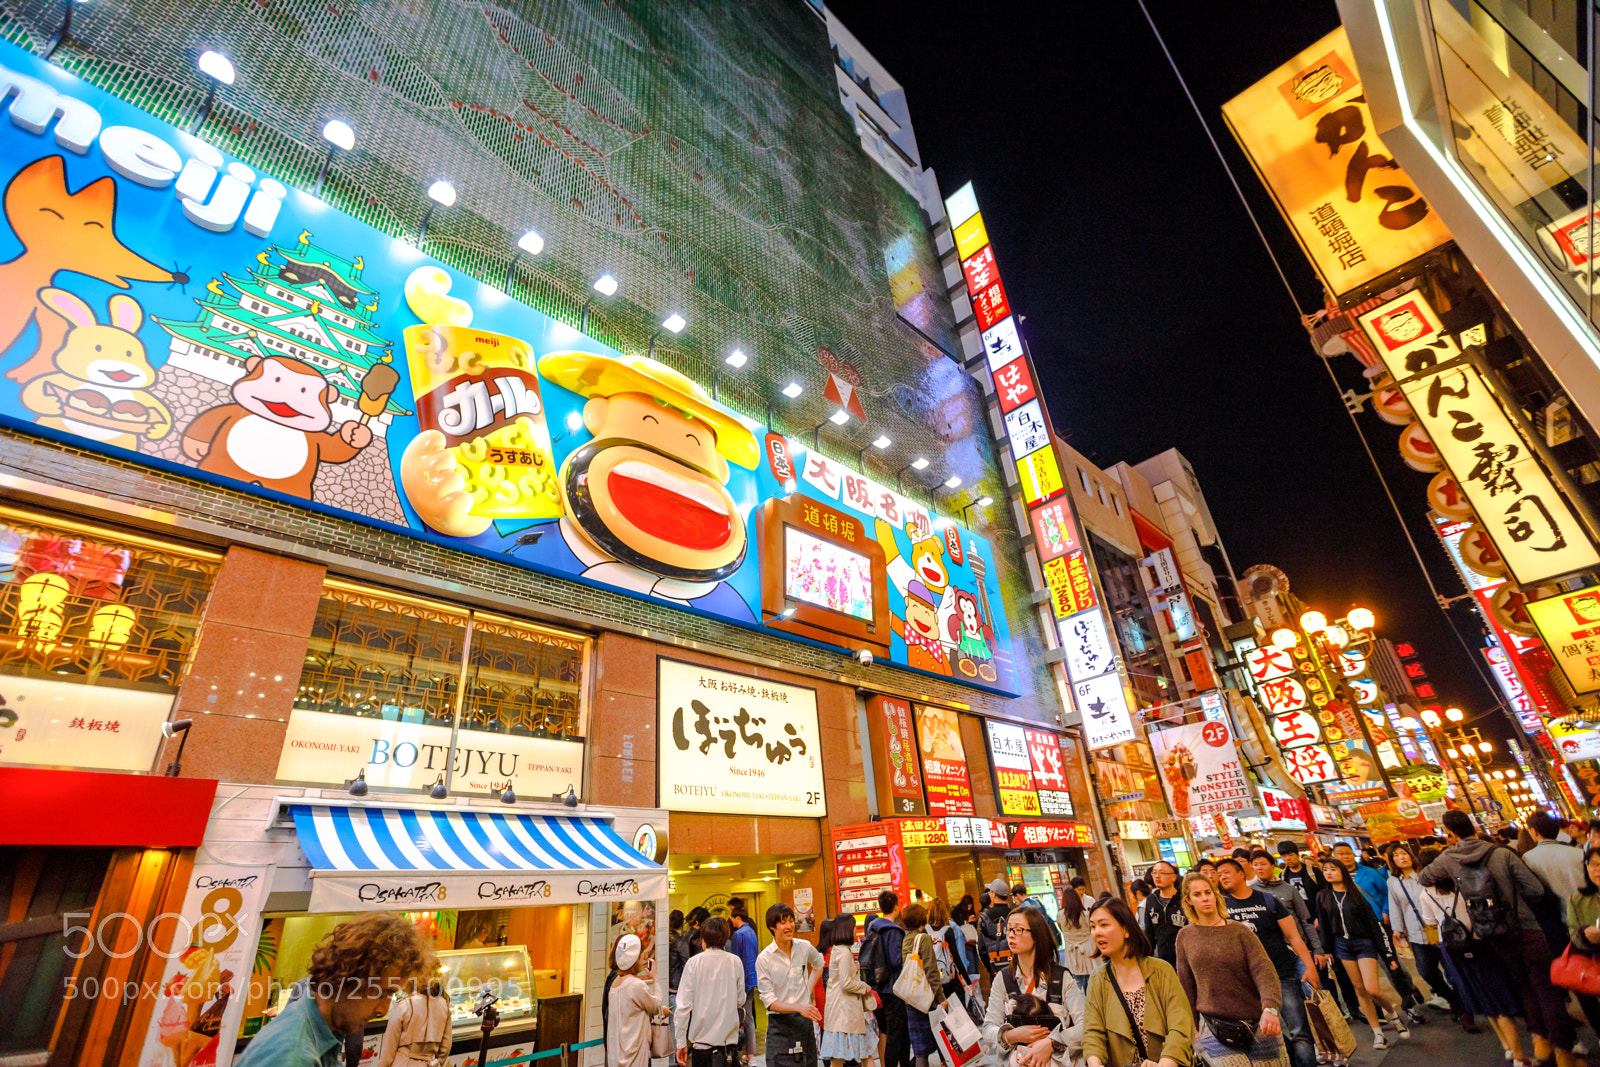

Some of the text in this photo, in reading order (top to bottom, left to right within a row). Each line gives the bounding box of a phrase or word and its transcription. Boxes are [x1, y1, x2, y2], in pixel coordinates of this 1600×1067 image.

[0, 66, 288, 238] meiji
[1309, 202, 1367, 271] 道頓堀店
[475, 337, 500, 347] meiji
[984, 331, 994, 341] 6F
[998, 364, 1029, 404] はや
[438, 376, 541, 436] カール
[1018, 411, 1043, 451] 白木屋
[490, 449, 544, 466] うすあじ
[771, 440, 791, 478] 日本一
[808, 457, 931, 535] 大阪名物
[803, 503, 856, 542] 道頓堀
[946, 526, 960, 559] 日本一
[1070, 550, 1082, 560] 2F
[1562, 640, 1599, 658] 個室
[698, 675, 789, 704] 大阪 お好み焼・鉄板焼
[1078, 684, 1091, 697] 6F
[1252, 647, 1328, 783] 大阪王将
[69, 716, 121, 733] 鉄板焼
[672, 699, 807, 765] ぼてぢゅう
[883, 700, 907, 787] いしんでん
[992, 732, 1024, 754] 白木屋
[1204, 727, 1225, 743] 2F
[291, 739, 360, 754] OKONOMI-YAKI
[368, 738, 520, 778] BOTEJYU
[1222, 760, 1239, 771] NY
[527, 763, 573, 774] TEPPAN-YAKI
[729, 765, 765, 778] Since 1946
[1206, 770, 1243, 782] STYLE
[469, 781, 488, 790] Since
[673, 784, 717, 797] BOTEJYU
[1191, 778, 1245, 795] MONSTER
[806, 791, 821, 805] 2F
[1200, 787, 1249, 802] PALFEIT
[903, 798, 915, 812] 3F
[952, 820, 984, 839] 白木屋
[1023, 825, 1075, 844] 相席ダイニング
